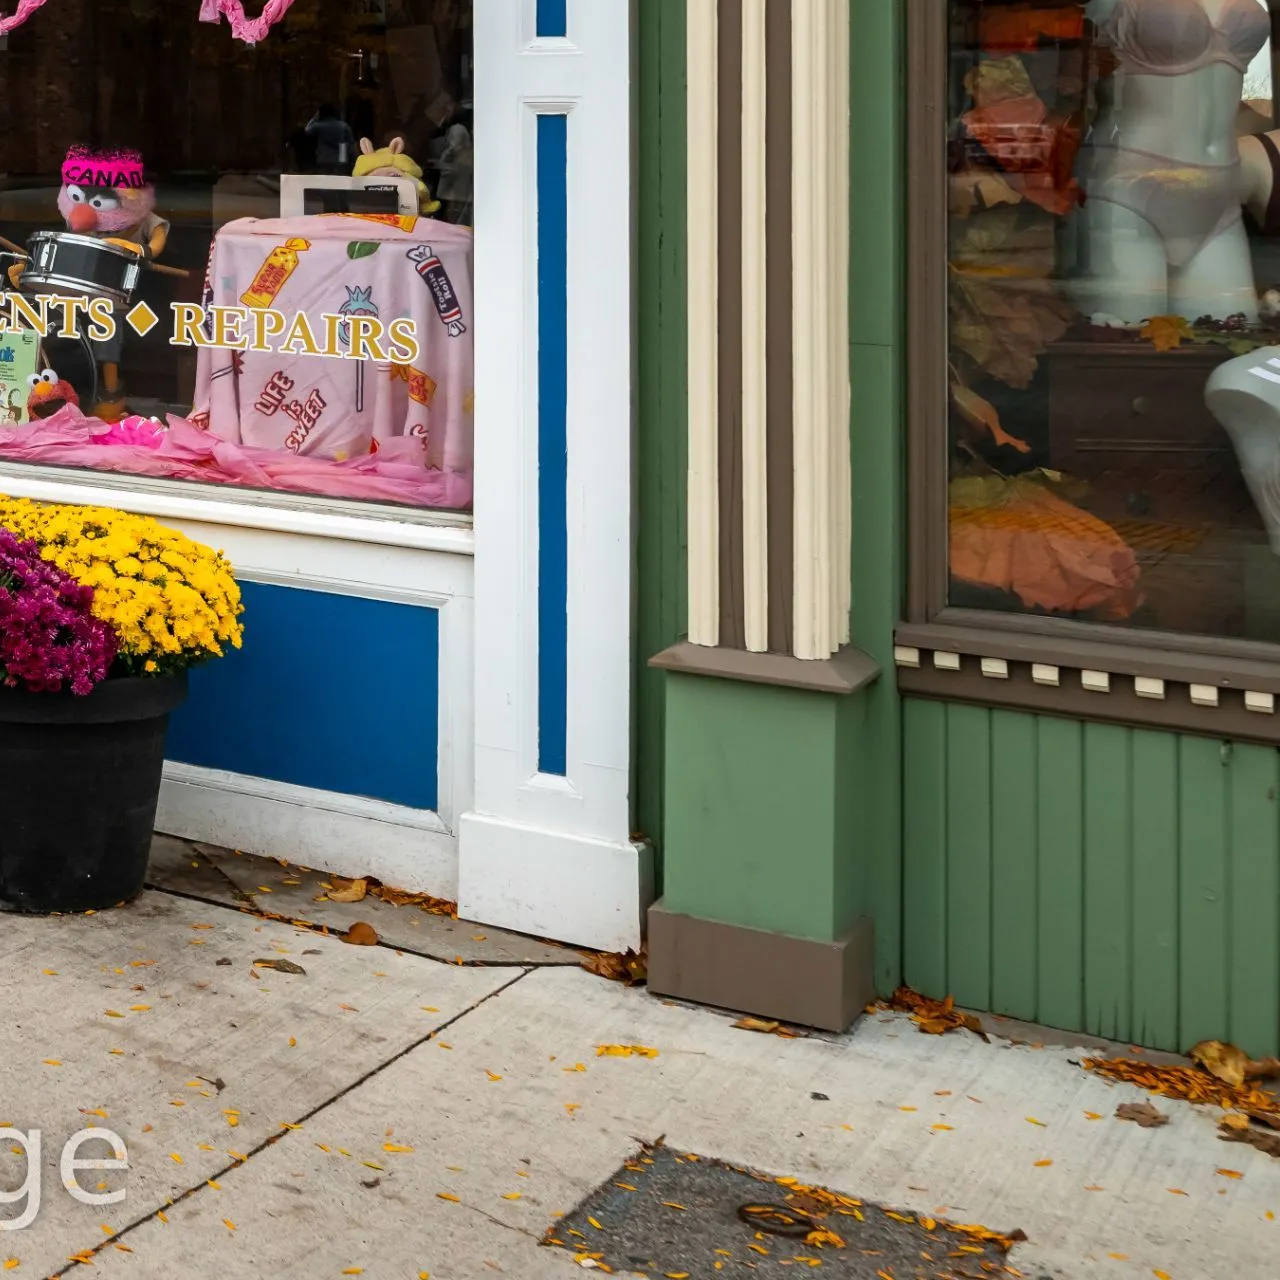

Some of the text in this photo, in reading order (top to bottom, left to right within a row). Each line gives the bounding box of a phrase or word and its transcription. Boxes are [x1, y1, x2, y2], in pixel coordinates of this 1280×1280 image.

[170, 302, 420, 364] REPAIRS
[254, 370, 295, 416] LIFE
[285, 388, 327, 455] SWEET
